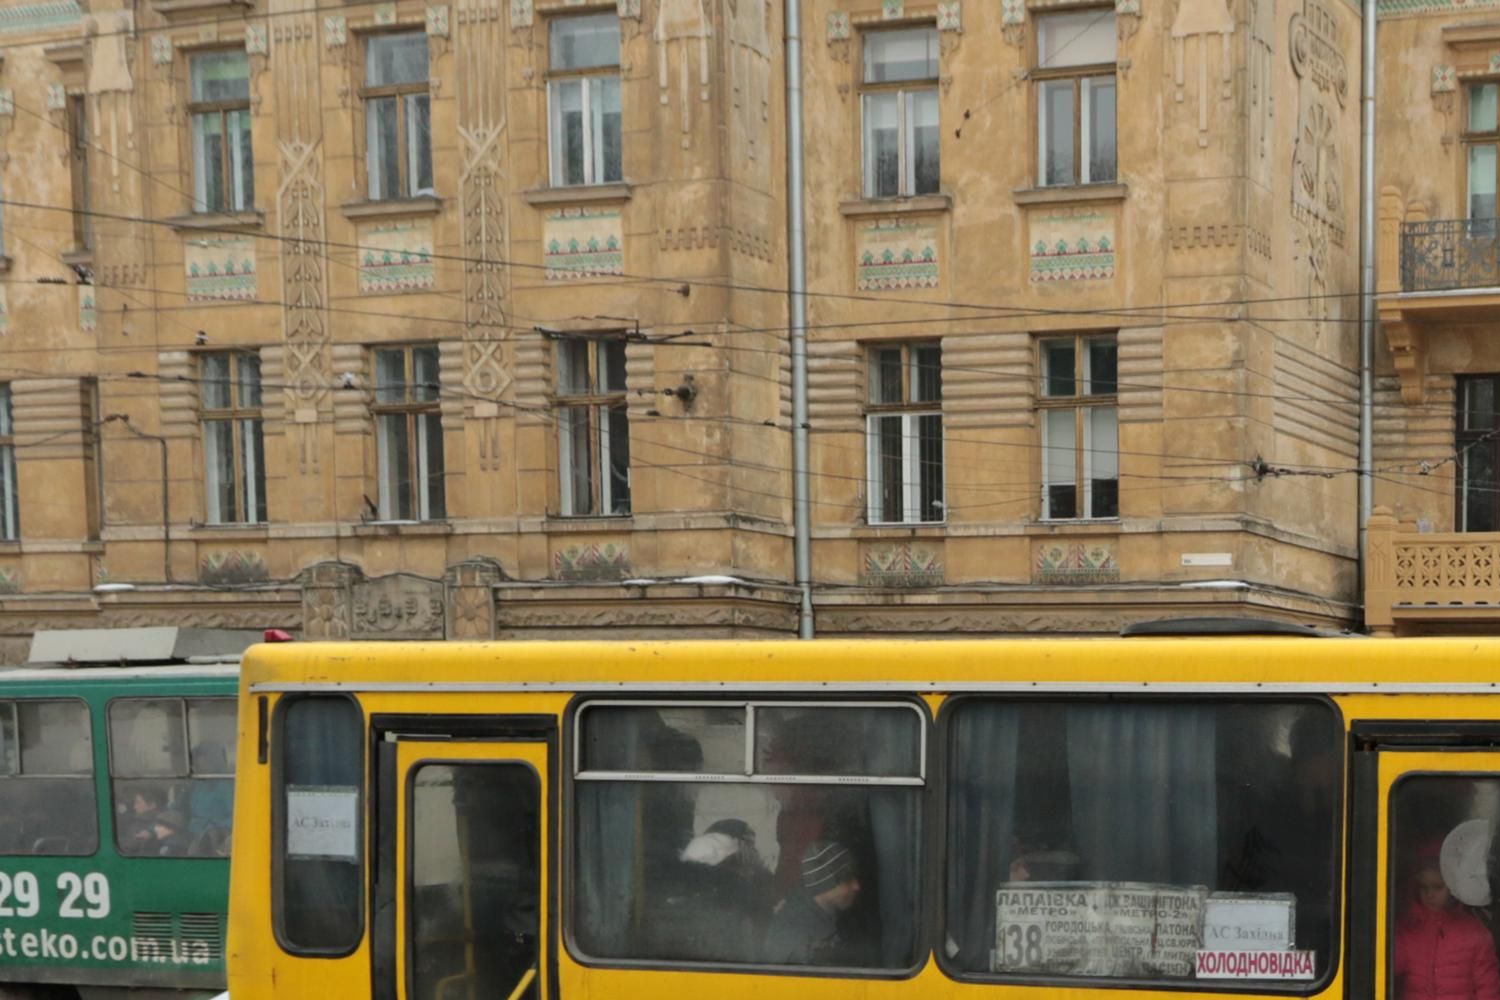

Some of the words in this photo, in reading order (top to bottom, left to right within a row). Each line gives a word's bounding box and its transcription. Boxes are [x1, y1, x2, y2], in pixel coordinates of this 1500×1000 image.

[56, 872, 110, 918] 29
[0, 927, 209, 964] teko.com.ua
[1208, 926, 1230, 939] АС
[1198, 952, 1313, 977] ХОЛОДНОВІДКА
